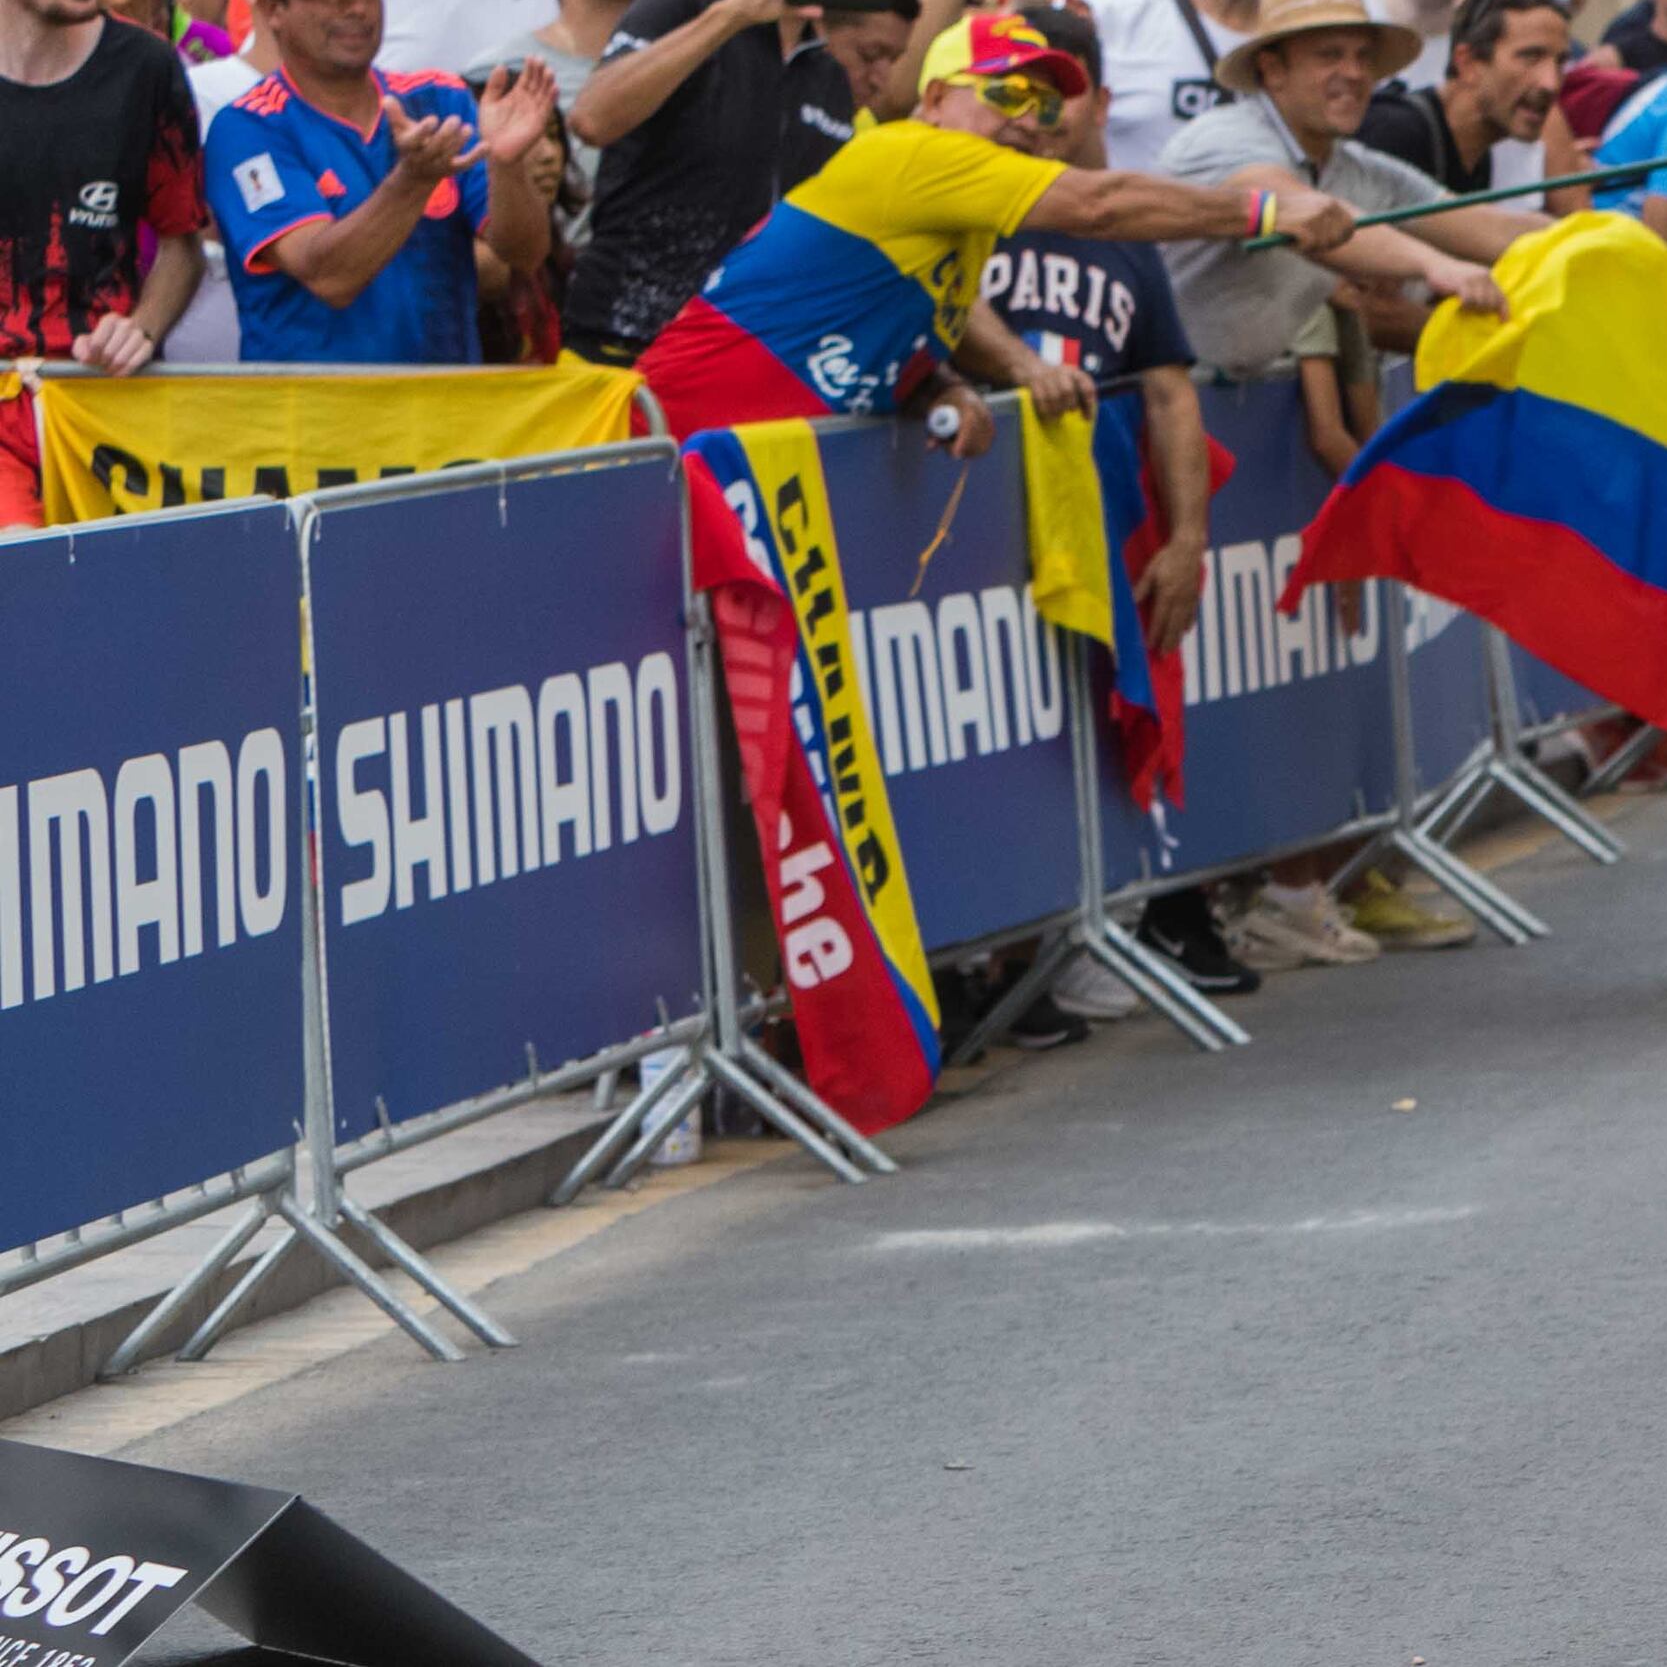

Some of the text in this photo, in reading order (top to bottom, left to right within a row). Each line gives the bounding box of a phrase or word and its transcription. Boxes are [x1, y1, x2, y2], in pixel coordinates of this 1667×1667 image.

[979, 247, 1136, 353] PARIS
[336, 651, 682, 927] SHIMANO
[0, 1531, 190, 1636] SSOT
